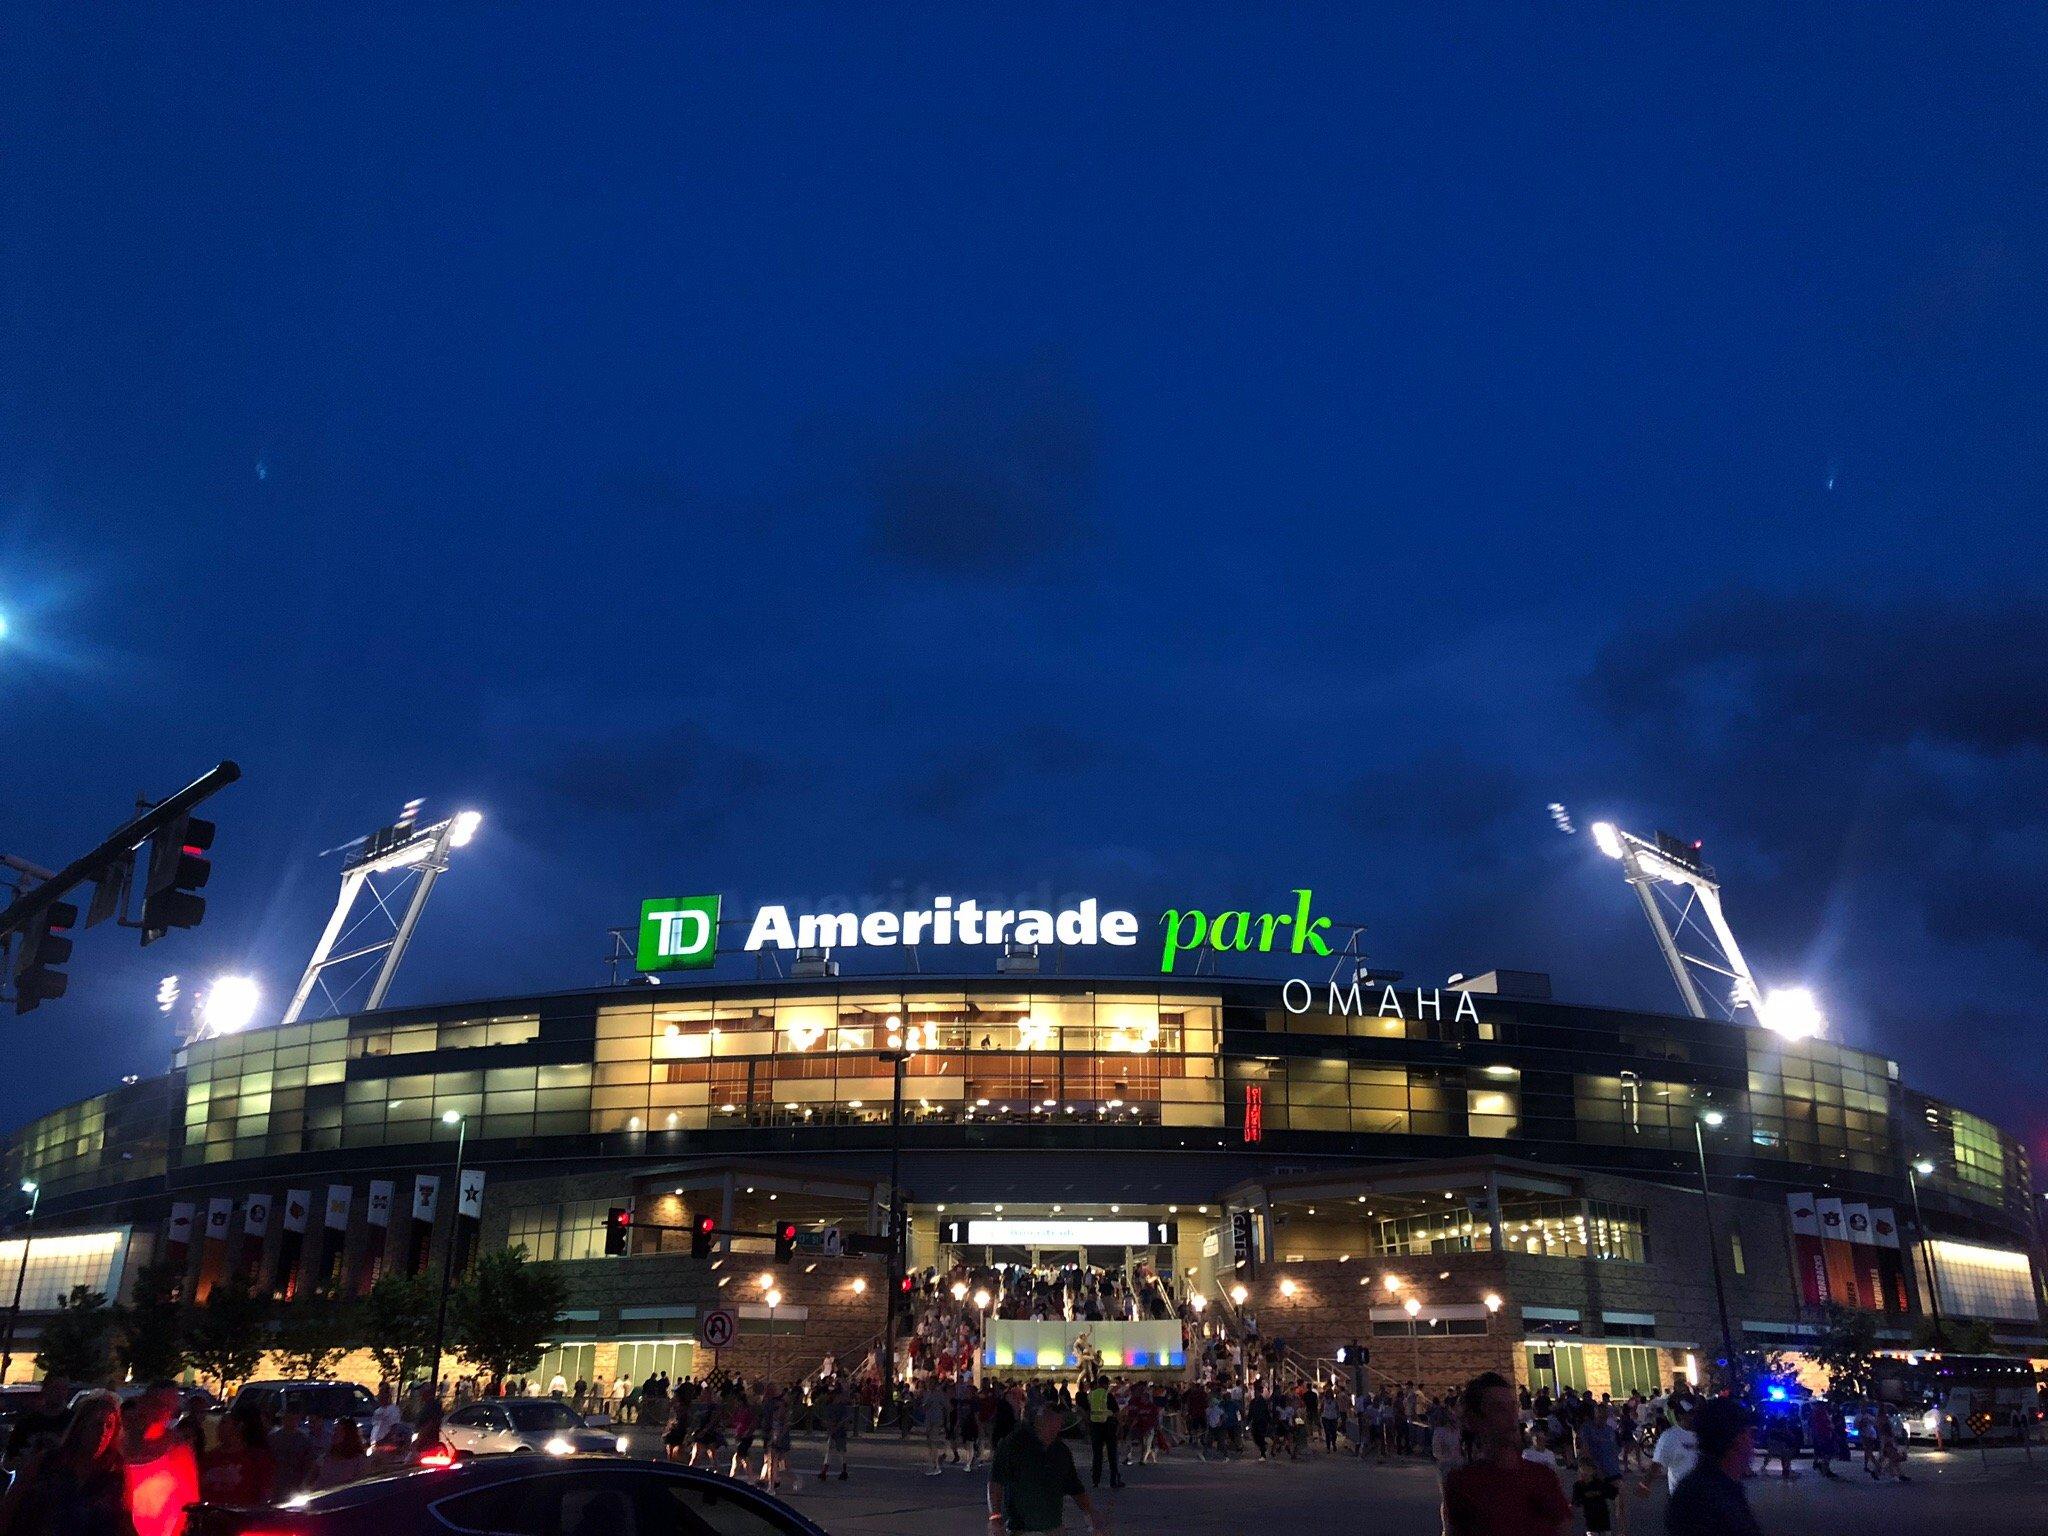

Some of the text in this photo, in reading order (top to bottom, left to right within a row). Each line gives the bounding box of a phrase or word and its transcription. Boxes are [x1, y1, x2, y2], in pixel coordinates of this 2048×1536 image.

[648, 889, 1334, 973] TD Ameritrade park
[1283, 979, 1480, 1023] OMAHA
[948, 1222, 958, 1242] 1
[1157, 1223, 1167, 1243] 1
[1233, 1214, 1246, 1256] GATE
